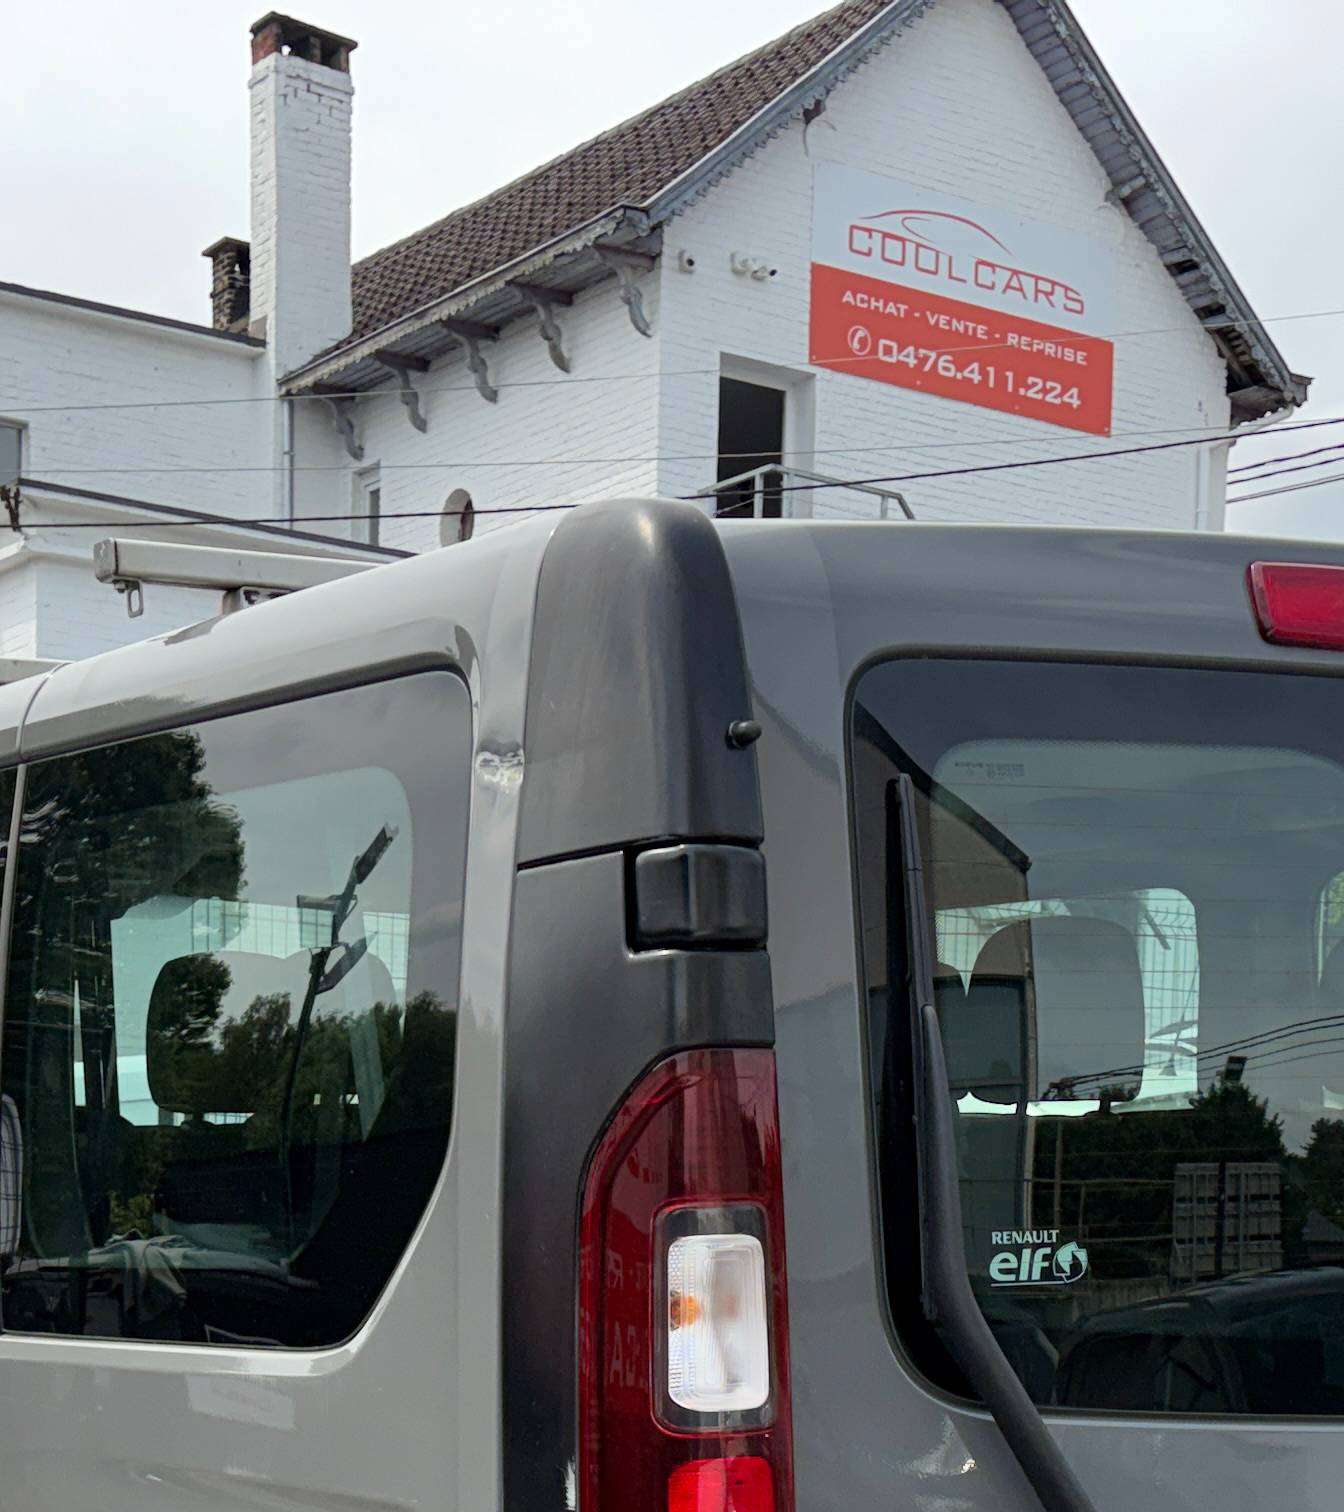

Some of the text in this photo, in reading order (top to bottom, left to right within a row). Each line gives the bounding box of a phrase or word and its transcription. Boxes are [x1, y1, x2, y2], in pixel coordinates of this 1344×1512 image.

[848, 224, 1085, 316] COOLCARS
[842, 290, 909, 319] ACHAT
[926, 310, 989, 340] VENTE
[1007, 332, 1088, 366] REPRISE
[878, 338, 1082, 410] 0476.411.224
[989, 1247, 1052, 1282] elf
[991, 1229, 1060, 1245] RENAULT
